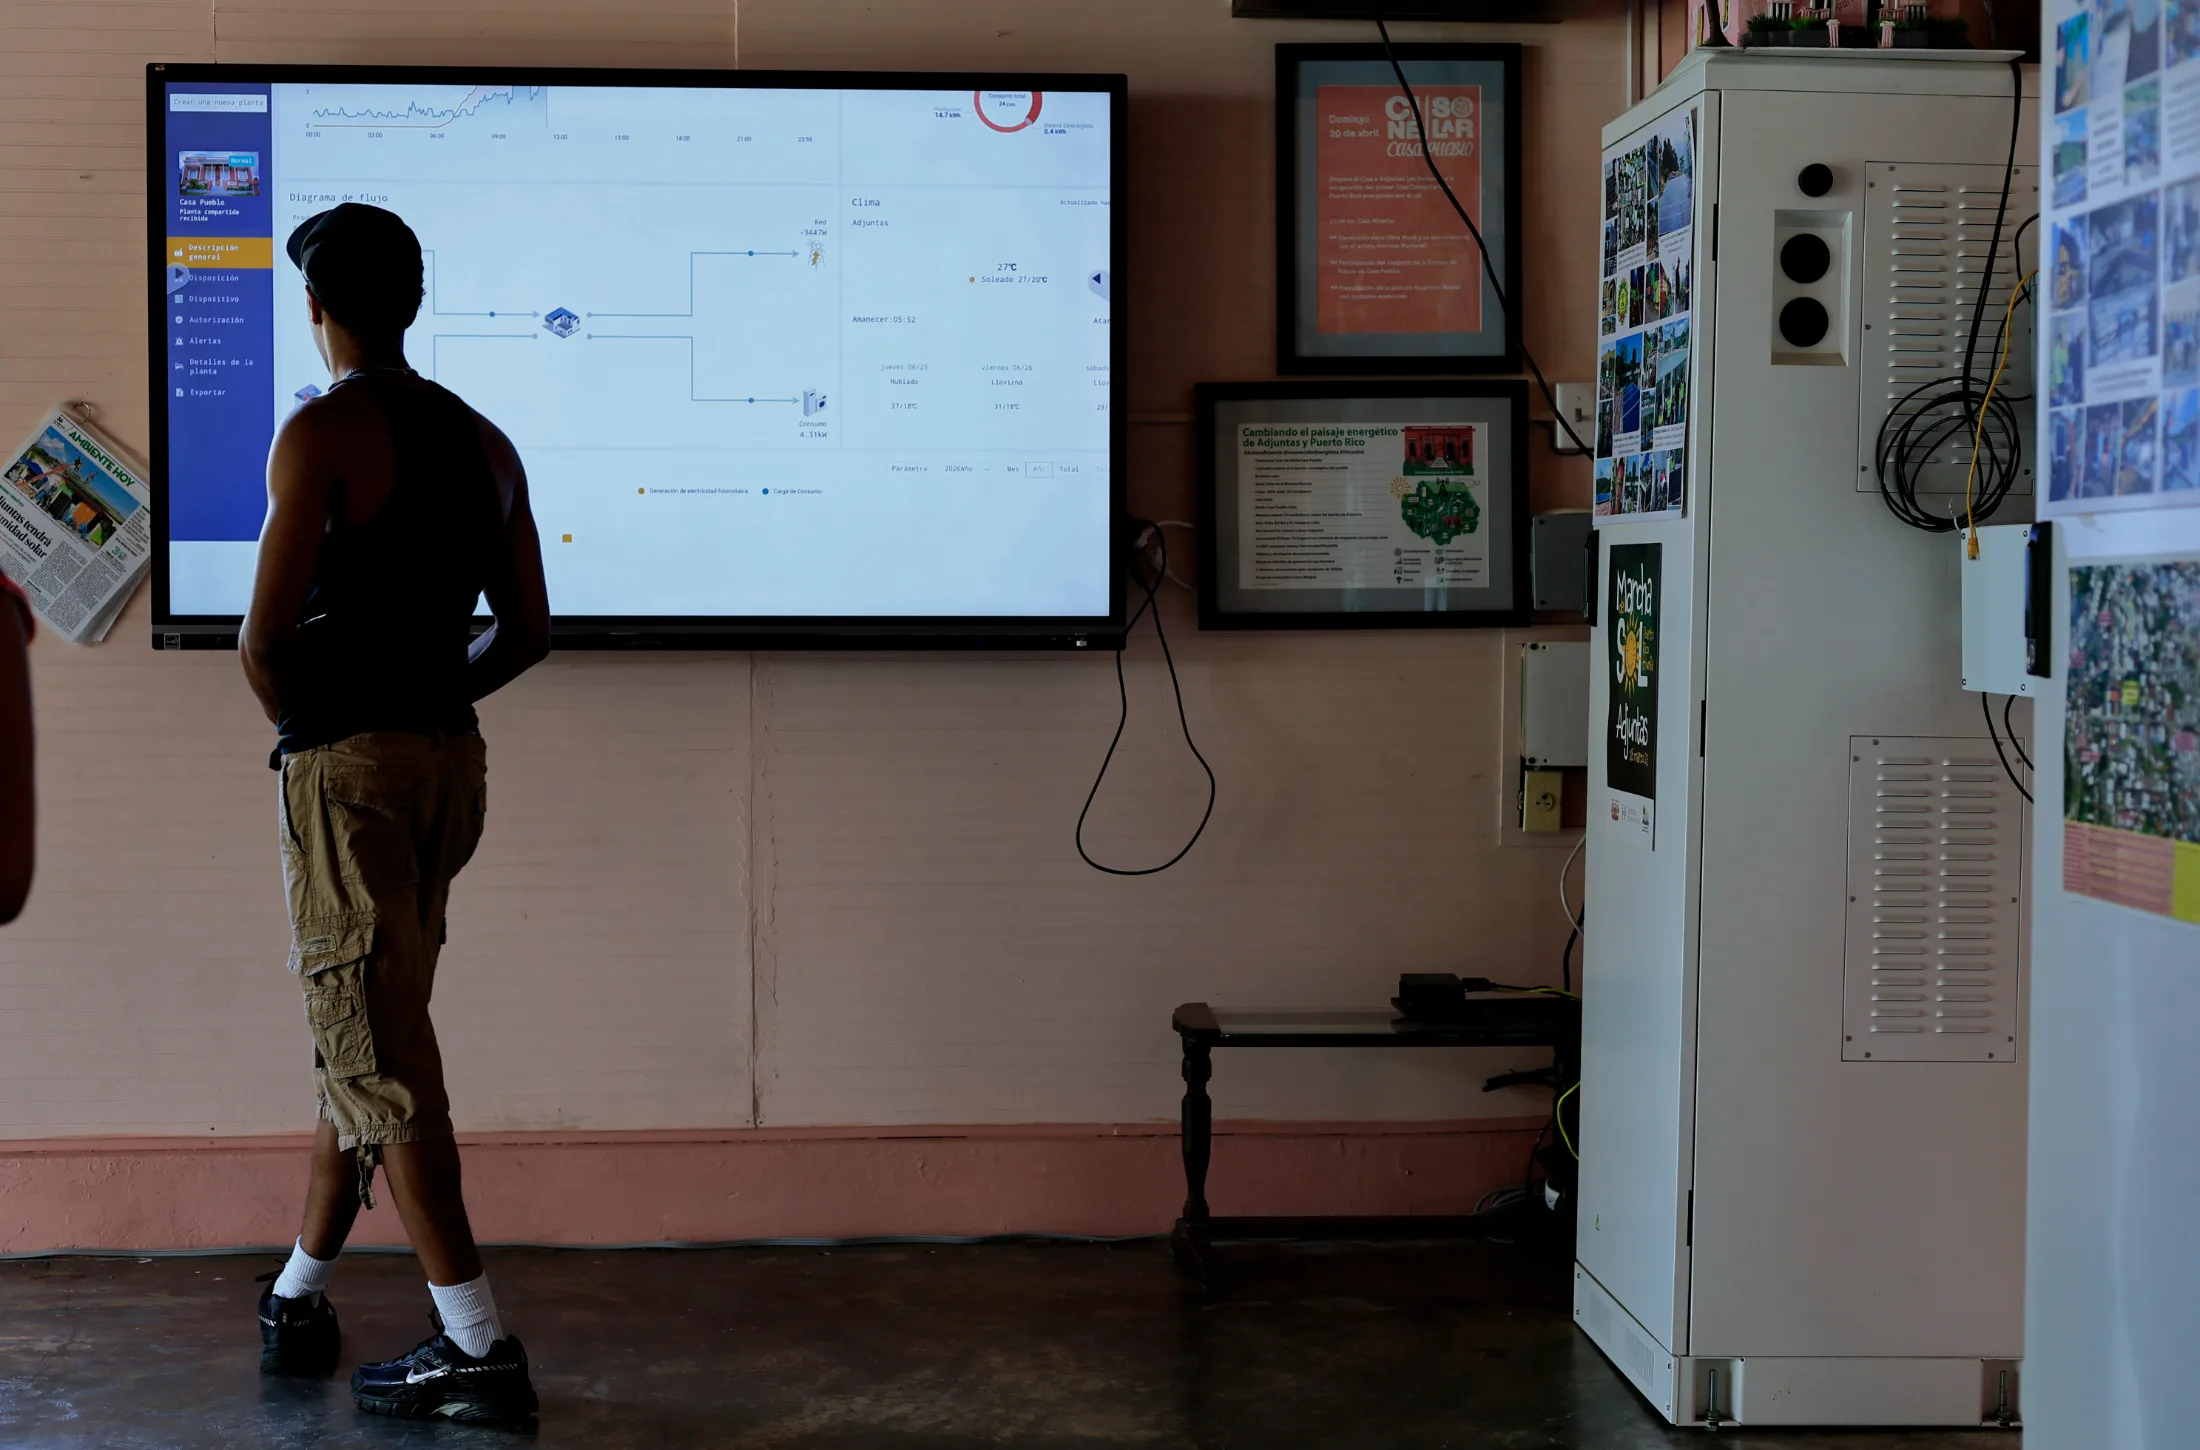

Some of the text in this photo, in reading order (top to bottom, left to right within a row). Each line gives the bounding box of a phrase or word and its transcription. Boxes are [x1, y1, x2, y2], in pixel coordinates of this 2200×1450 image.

[173, 98, 194, 106] Crear
[238, 98, 265, 108] planta
[1329, 115, 1371, 126] Domingo
[1342, 129, 1356, 137] de
[1358, 127, 1378, 137] abril
[230, 156, 253, 164] Normal
[289, 193, 388, 205] Diagrama de flujo
[852, 197, 881, 207] Clima
[179, 208, 240, 217] Planta compartida
[814, 218, 889, 228] Red Adjuntas
[188, 243, 239, 253] Descripción
[188, 253, 221, 262] general
[189, 273, 239, 283] Disposición
[981, 275, 1014, 284] Soleado
[189, 295, 240, 305] Dispositivo
[189, 315, 244, 324] Autorización
[852, 315, 916, 324] Amanecer:05:52
[190, 337, 222, 346] Alertas
[190, 358, 254, 367] Detalles de la
[880, 363, 905, 372] jueves
[907, 363, 928, 371] 06/25
[981, 363, 1009, 371] viernes
[1012, 363, 1033, 371] 06/26
[190, 367, 218, 377] planta
[890, 377, 918, 385] Nublado
[190, 388, 226, 398] Exportar
[798, 420, 828, 428] Consumo
[1242, 426, 1398, 439] Cambiando el paisaje energético
[1242, 436, 1365, 449] de Adjuntas y Puerto Rico
[68, 431, 115, 472] AMBIENTE
[891, 463, 928, 472] Parámetro
[944, 464, 973, 473] 2026Año
[1060, 465, 1080, 473] Total
[112, 466, 136, 488] HOY
[23, 520, 52, 547] tendrá
[24, 538, 47, 559] solar
[1616, 563, 1653, 616] Marcha
[1616, 703, 1649, 760] Adjuntas
